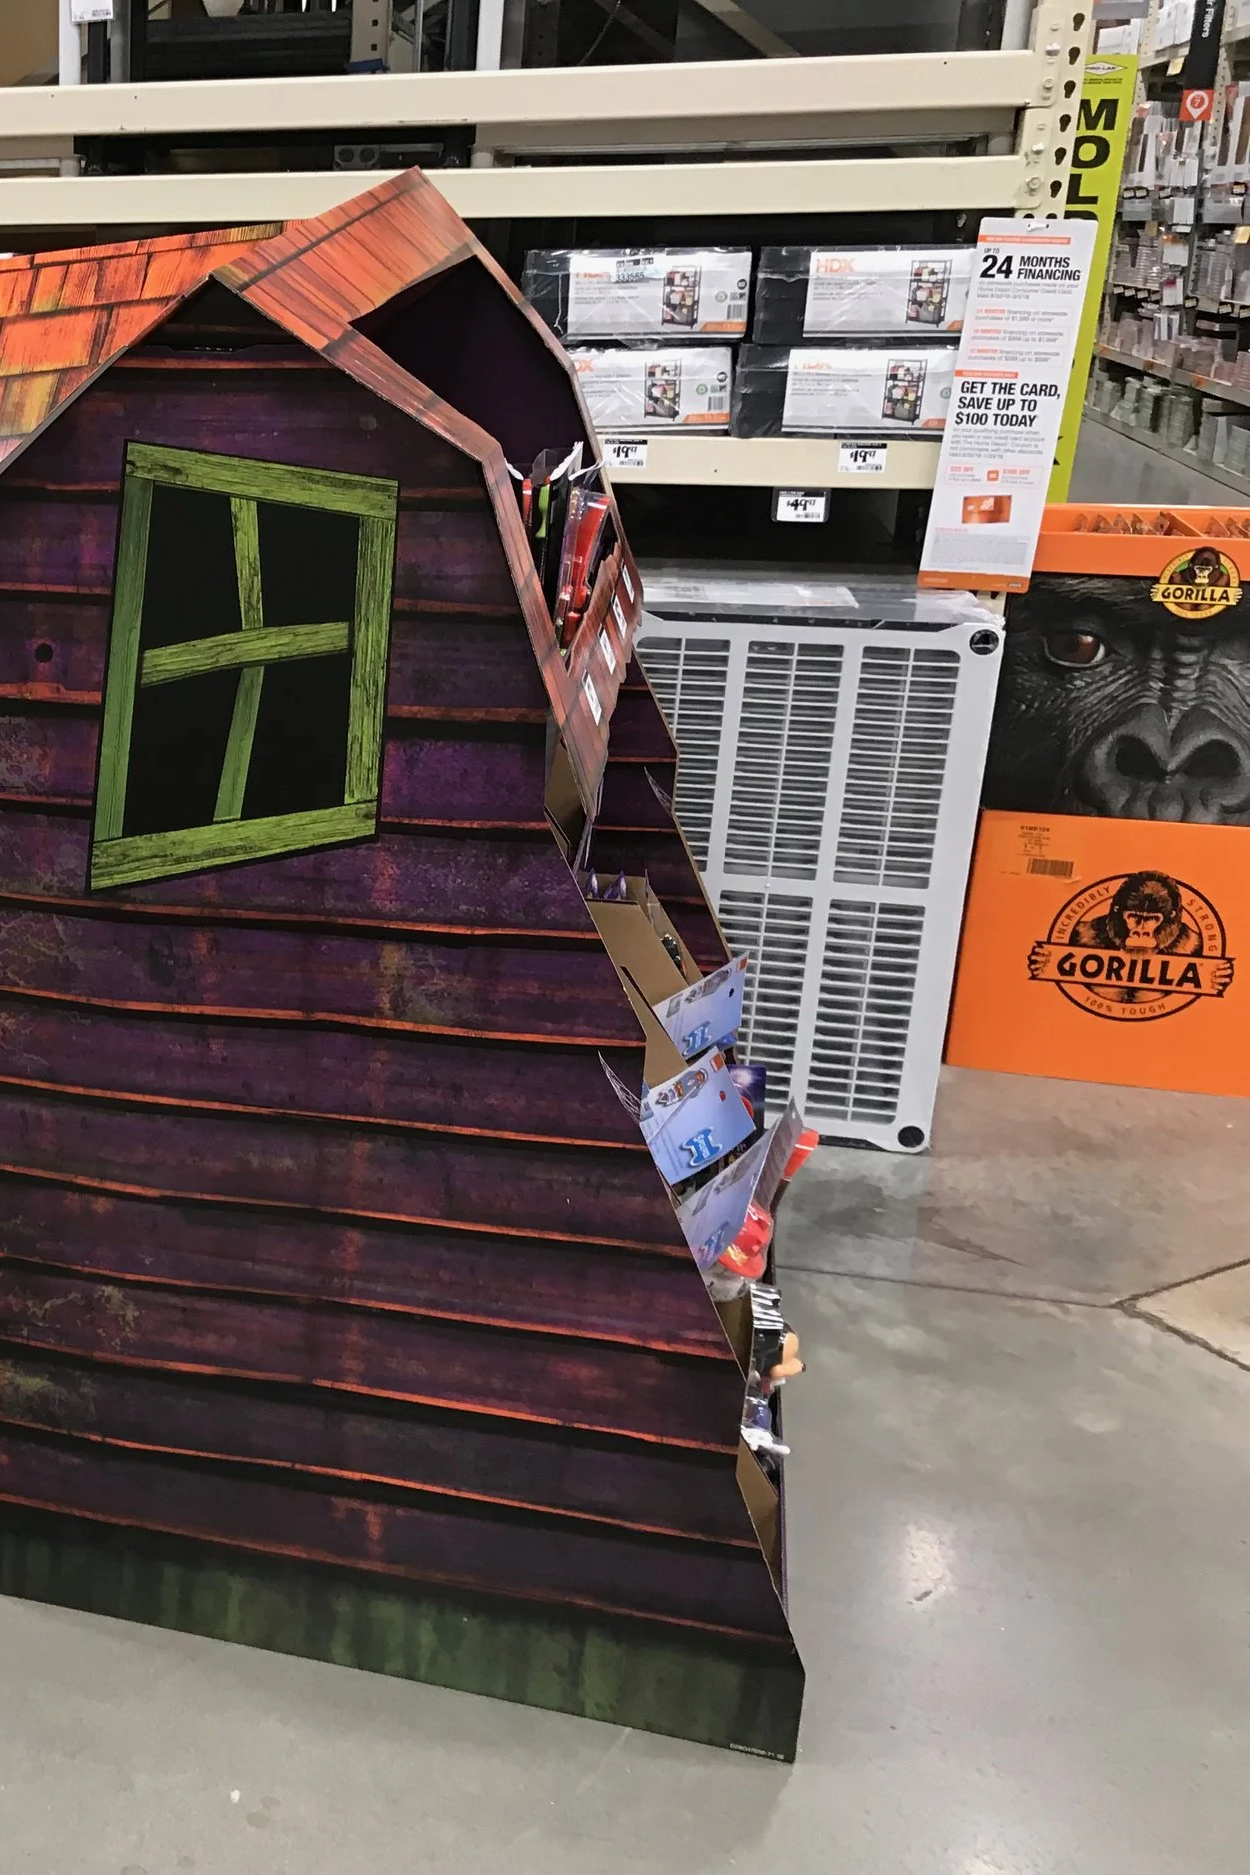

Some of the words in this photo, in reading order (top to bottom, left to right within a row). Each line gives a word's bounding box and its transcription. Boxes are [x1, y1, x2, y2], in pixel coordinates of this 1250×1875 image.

[1201, 8, 1215, 38] Filters
[815, 258, 855, 273] HDX
[979, 254, 1013, 279] 24
[1019, 256, 1070, 268] MONTHS
[1017, 268, 1081, 281] FINANCING
[960, 381, 987, 394] GET
[991, 382, 1017, 395] THE
[1020, 383, 1060, 400] CARD,
[957, 396, 993, 410] SAVE
[997, 398, 1016, 411] UP
[1021, 399, 1037, 412] TO
[954, 411, 988, 425] $100
[993, 413, 1037, 427] TODAY
[1161, 587, 1230, 602] GORILLA
[1055, 886, 1111, 940] INCREDIBLY
[1187, 899, 1218, 952] STRONG
[1057, 952, 1202, 989] GORILLA
[1122, 1003, 1167, 1016] TOUGH
